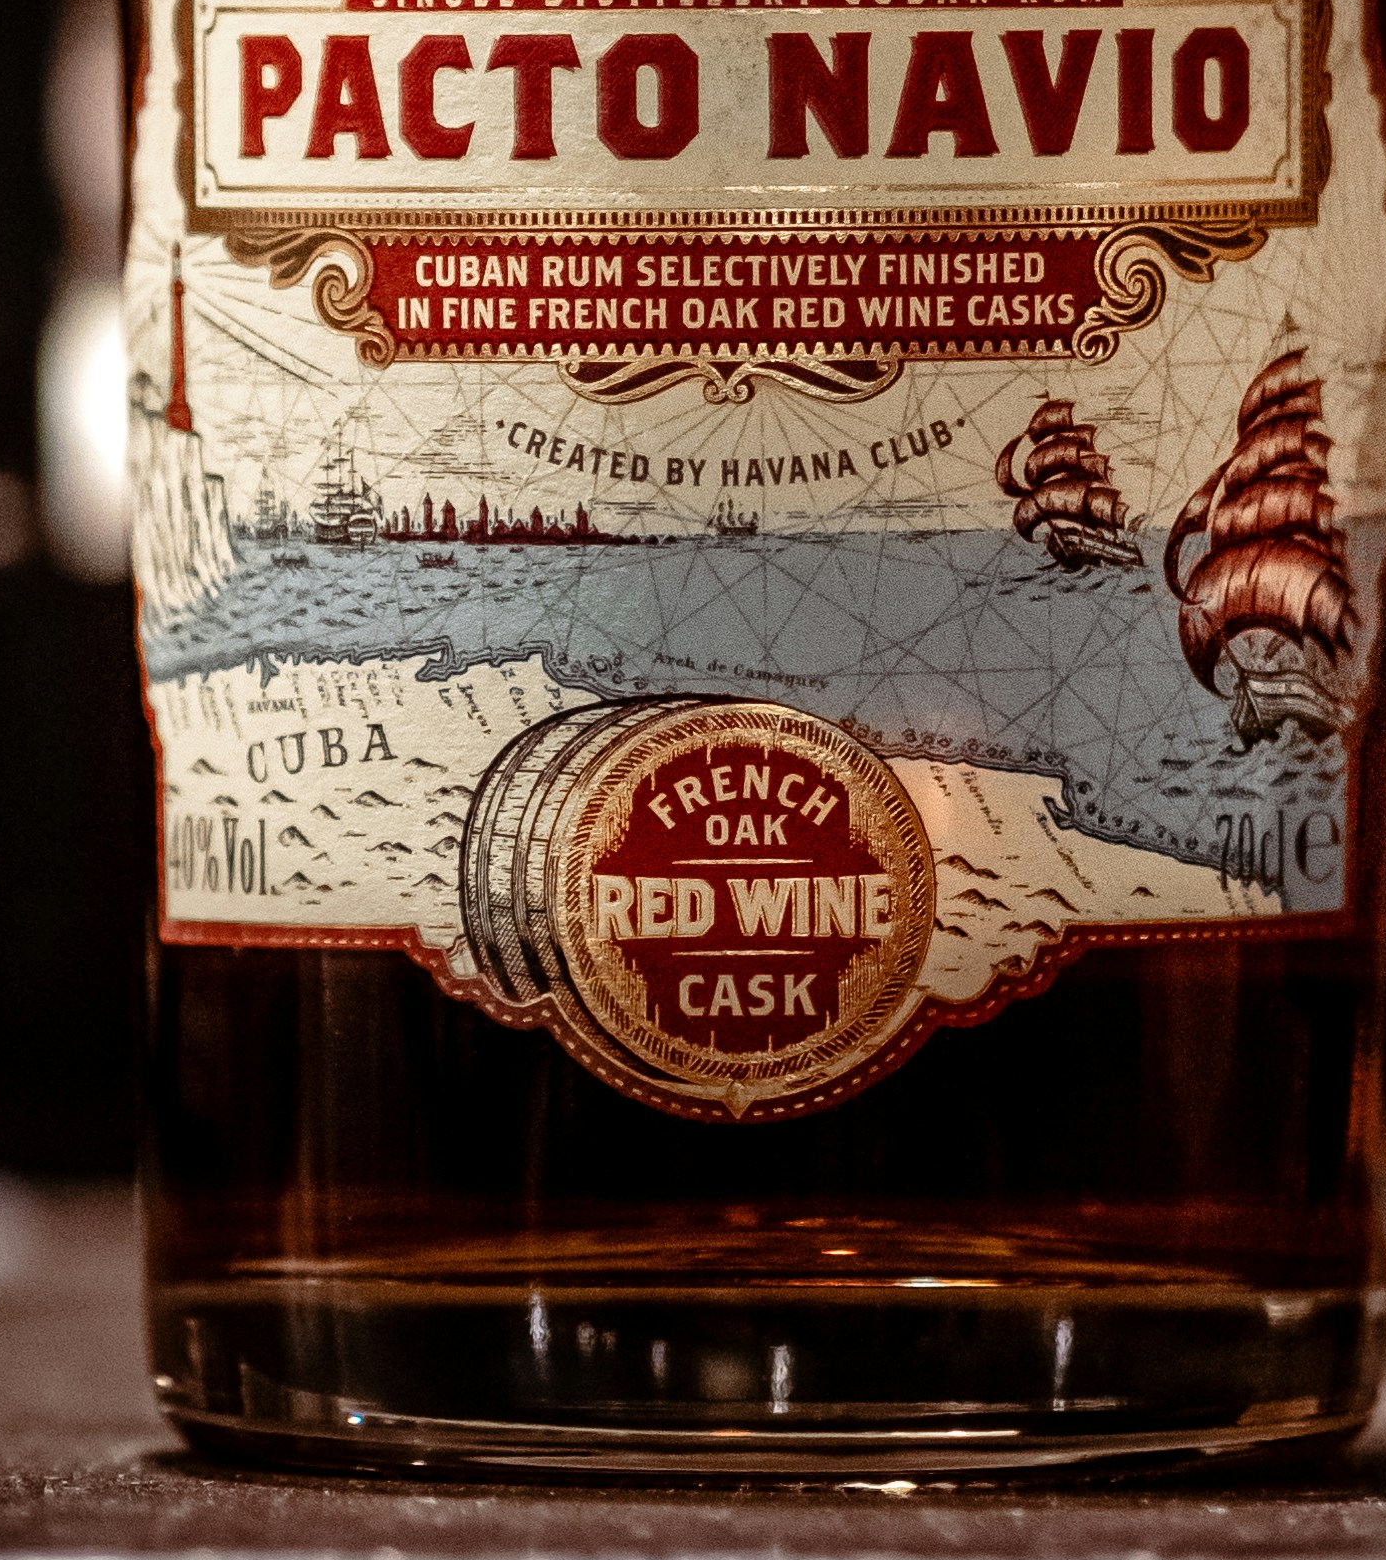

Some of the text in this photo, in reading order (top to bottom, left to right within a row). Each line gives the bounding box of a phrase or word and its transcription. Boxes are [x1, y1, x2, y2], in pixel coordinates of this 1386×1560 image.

[236, 26, 1252, 162] PACTO NAVIO
[414, 251, 1045, 288] CUBAN RUM SELECTIVELY FINISHED
[397, 292, 1076, 330] IN FINE FRENCH OAK RED WINE CASKS
[506, 420, 954, 488] CREATED BY HAVANA CLUB
[246, 723, 398, 783] CUBA
[646, 763, 841, 831] FRENCH
[705, 813, 789, 847] OAK
[592, 873, 898, 940] RED WINE
[677, 973, 819, 1018] CASK
